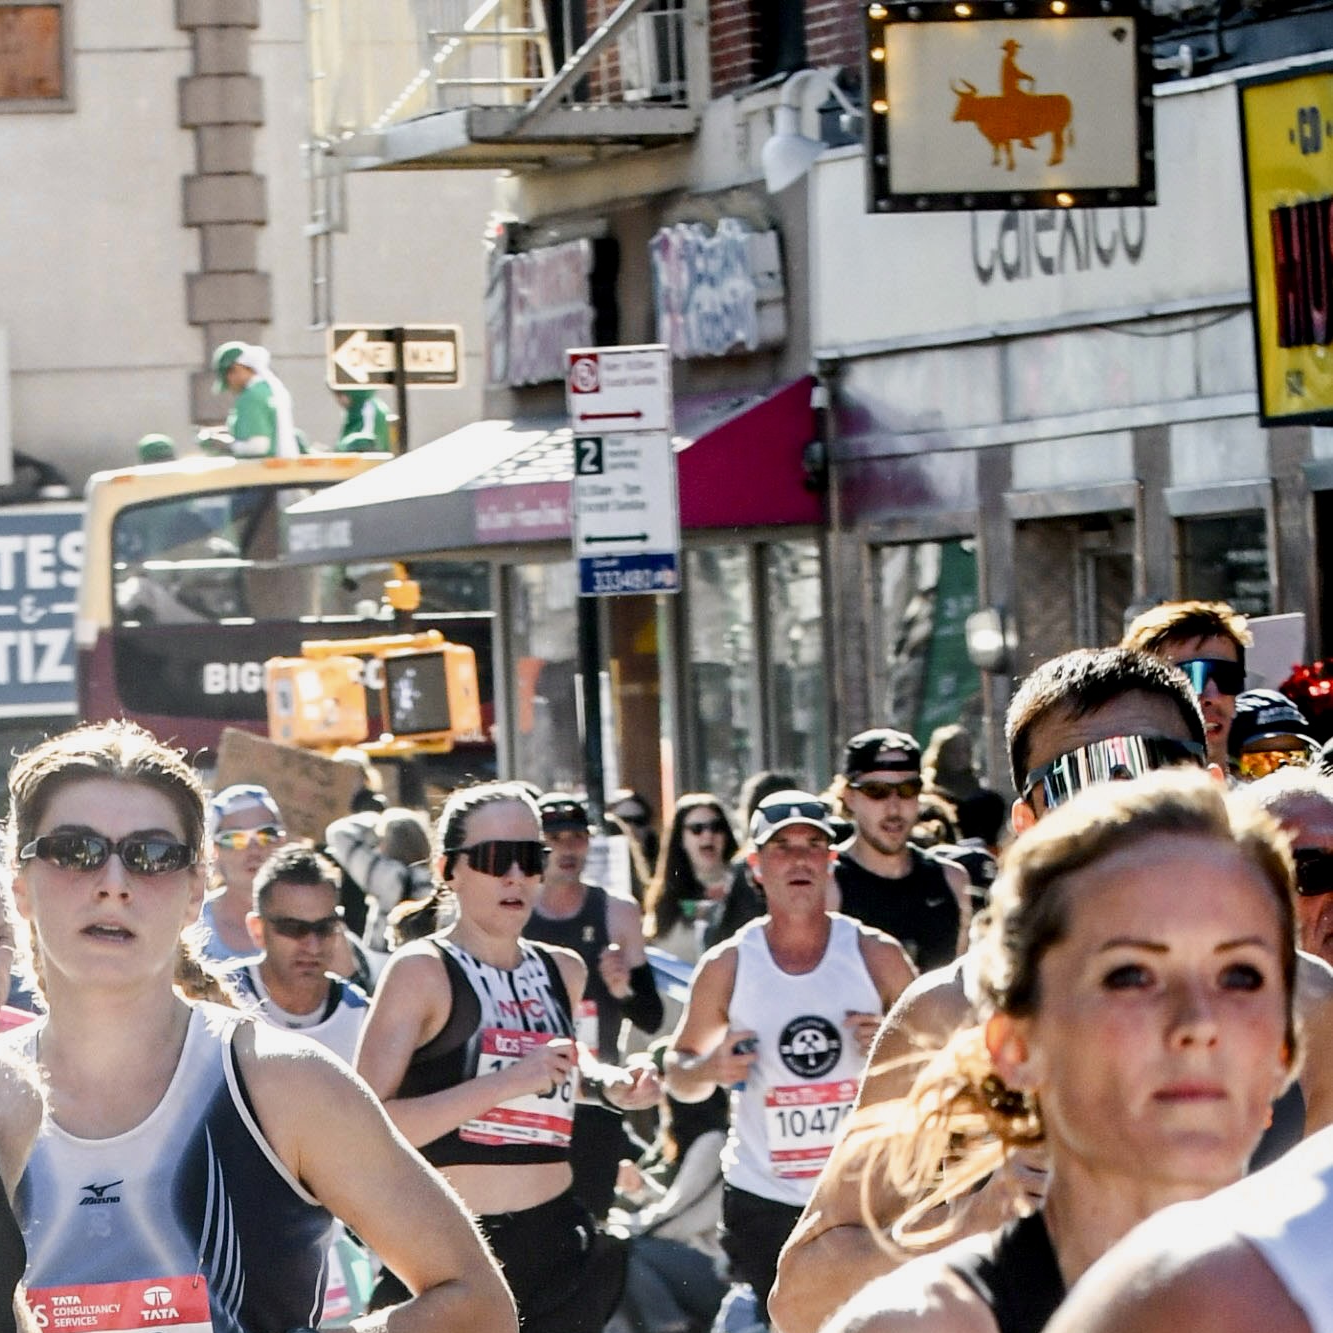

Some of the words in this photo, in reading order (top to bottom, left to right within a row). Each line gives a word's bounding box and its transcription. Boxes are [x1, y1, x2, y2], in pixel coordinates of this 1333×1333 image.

[347, 345, 386, 368] ONE
[579, 439, 600, 473] 2
[776, 1105, 854, 1138] 1047
[51, 1295, 82, 1306] TATA
[52, 1303, 121, 1317] CONSULTANCY
[140, 1307, 180, 1321] TATA
[53, 1316, 99, 1328] SERVICES
